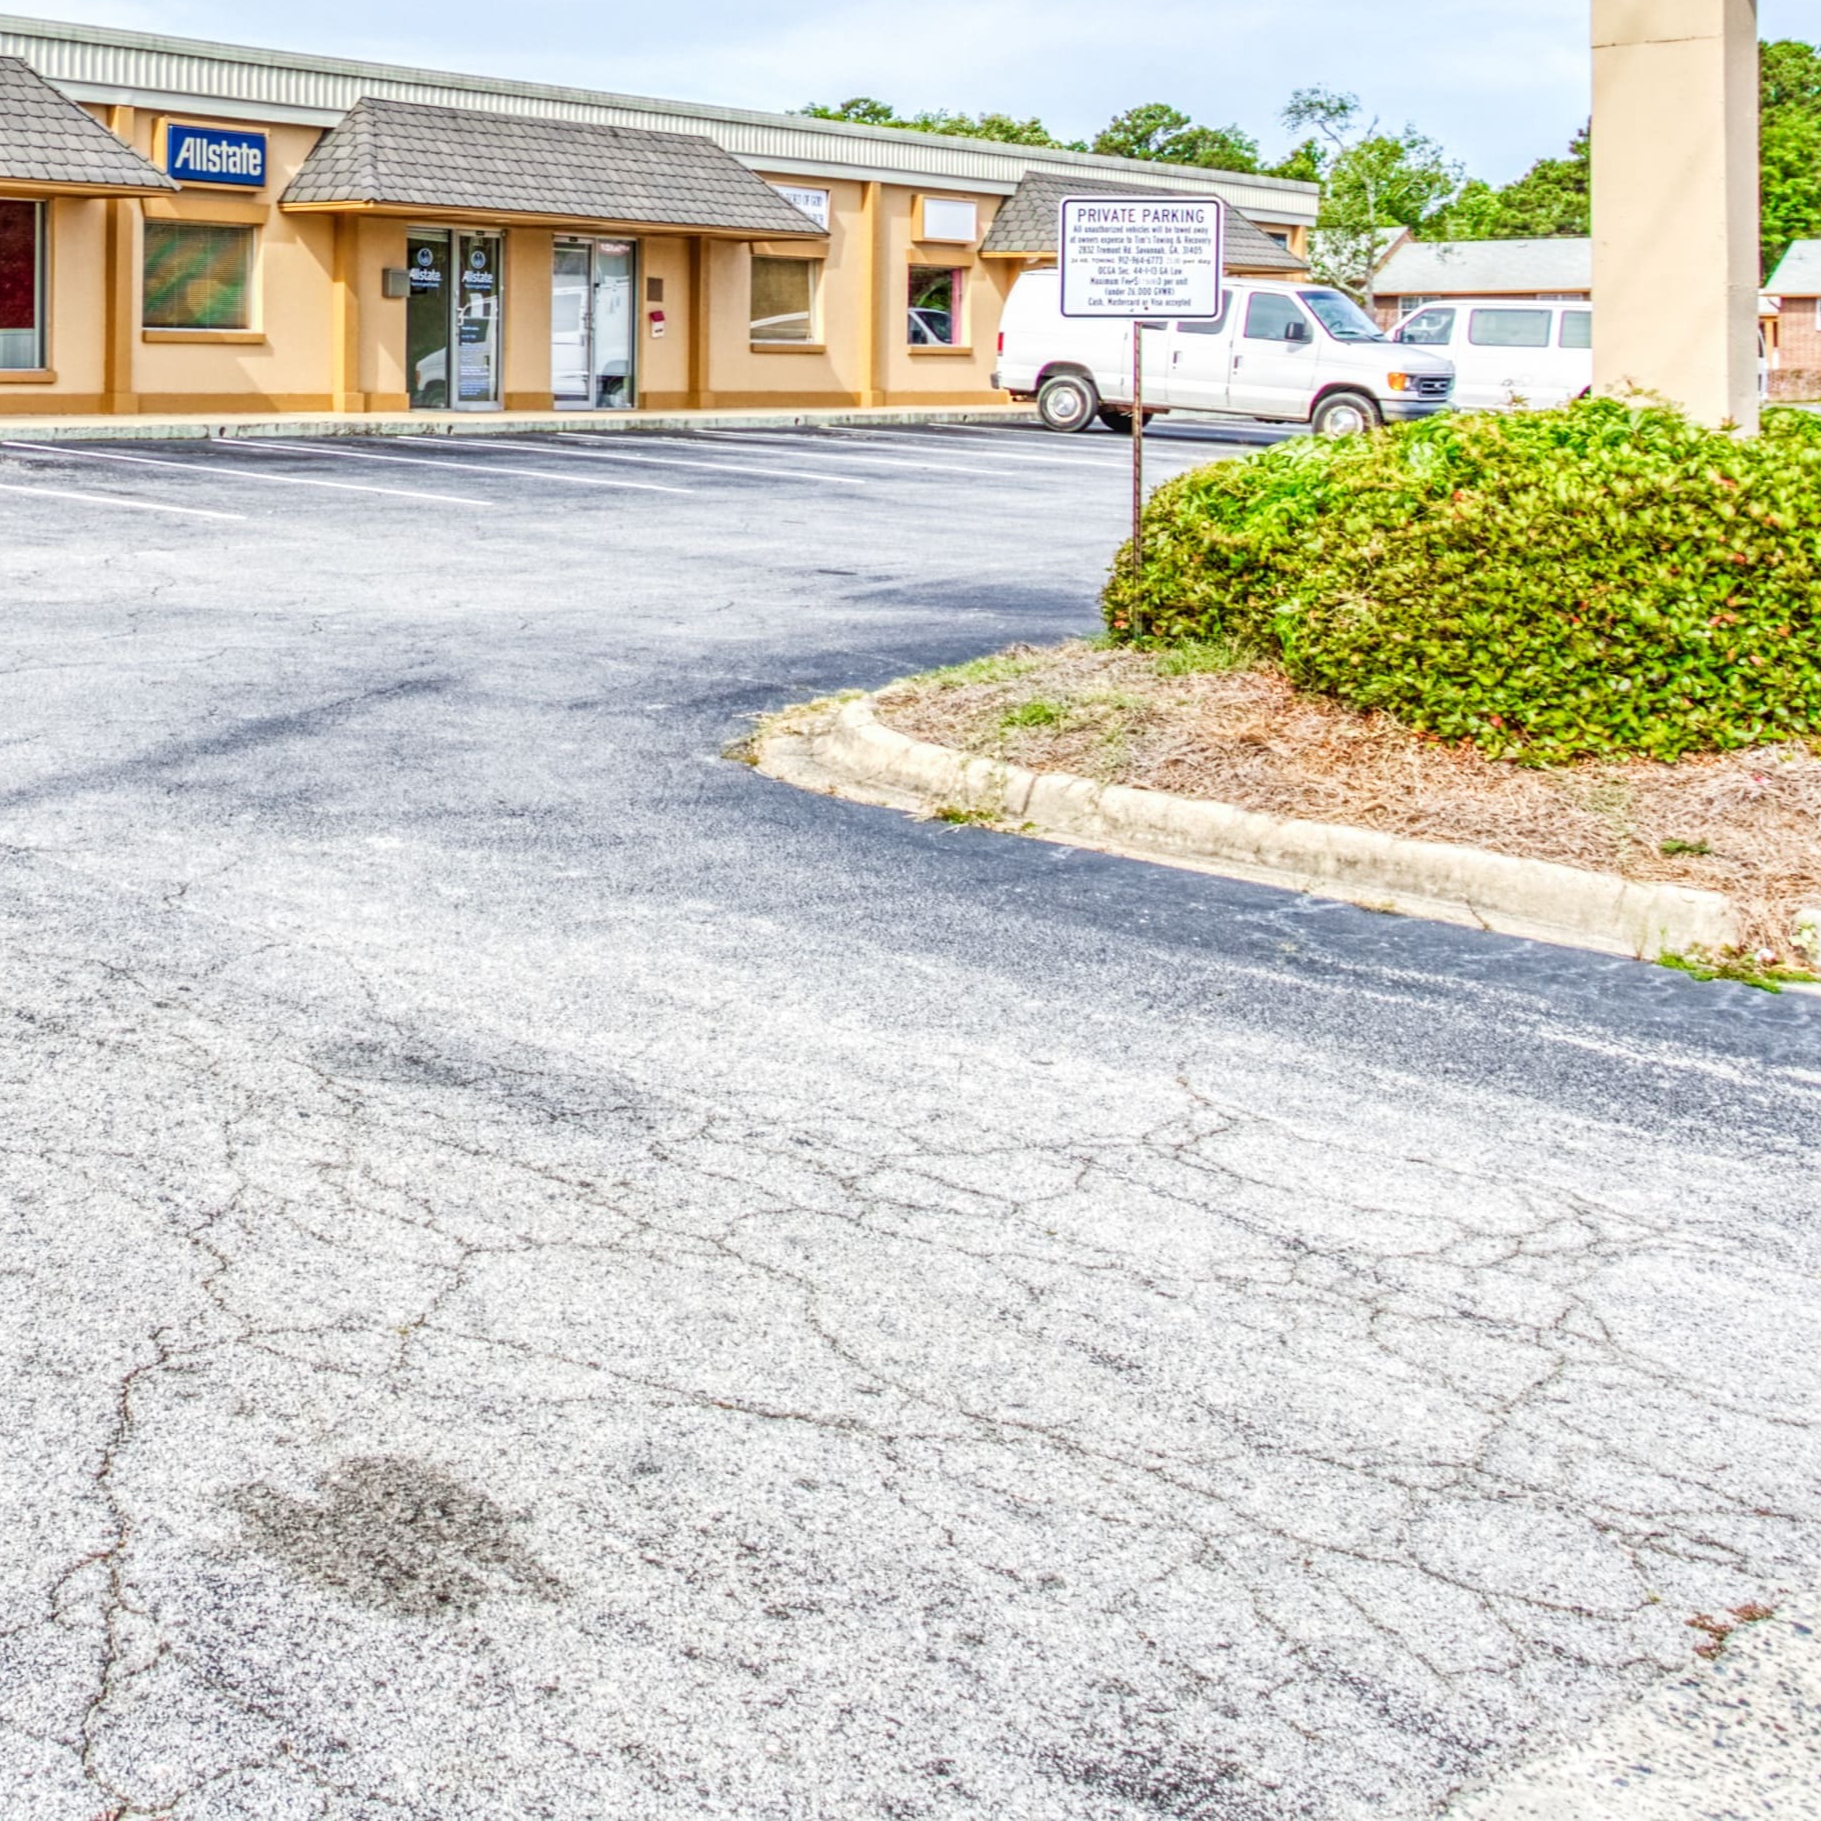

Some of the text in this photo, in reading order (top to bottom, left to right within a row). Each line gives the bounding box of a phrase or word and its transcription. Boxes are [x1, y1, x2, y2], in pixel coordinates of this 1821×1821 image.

[174, 137, 262, 176] Allstate
[1078, 208, 1205, 223] PRIVATE PARKING
[1174, 226, 1191, 234] towed
[1193, 227, 1208, 235] away
[1070, 235, 1077, 244] at
[1078, 236, 1098, 244] owners
[1100, 236, 1124, 245] expense
[1126, 236, 1133, 244] to
[1153, 235, 1174, 246] Towing
[1176, 235, 1182, 244] &
[1184, 236, 1211, 246] Recovery
[1096, 245, 1121, 254] Tremont
[409, 268, 441, 282] Allstate
[1170, 266, 1183, 275] Law
[462, 270, 494, 284] Allstate
[1089, 277, 1119, 285] Maximum
[1107, 298, 1140, 306] Mastercard
[1150, 298, 1164, 306] Visa
[1165, 298, 1191, 308] accepted
